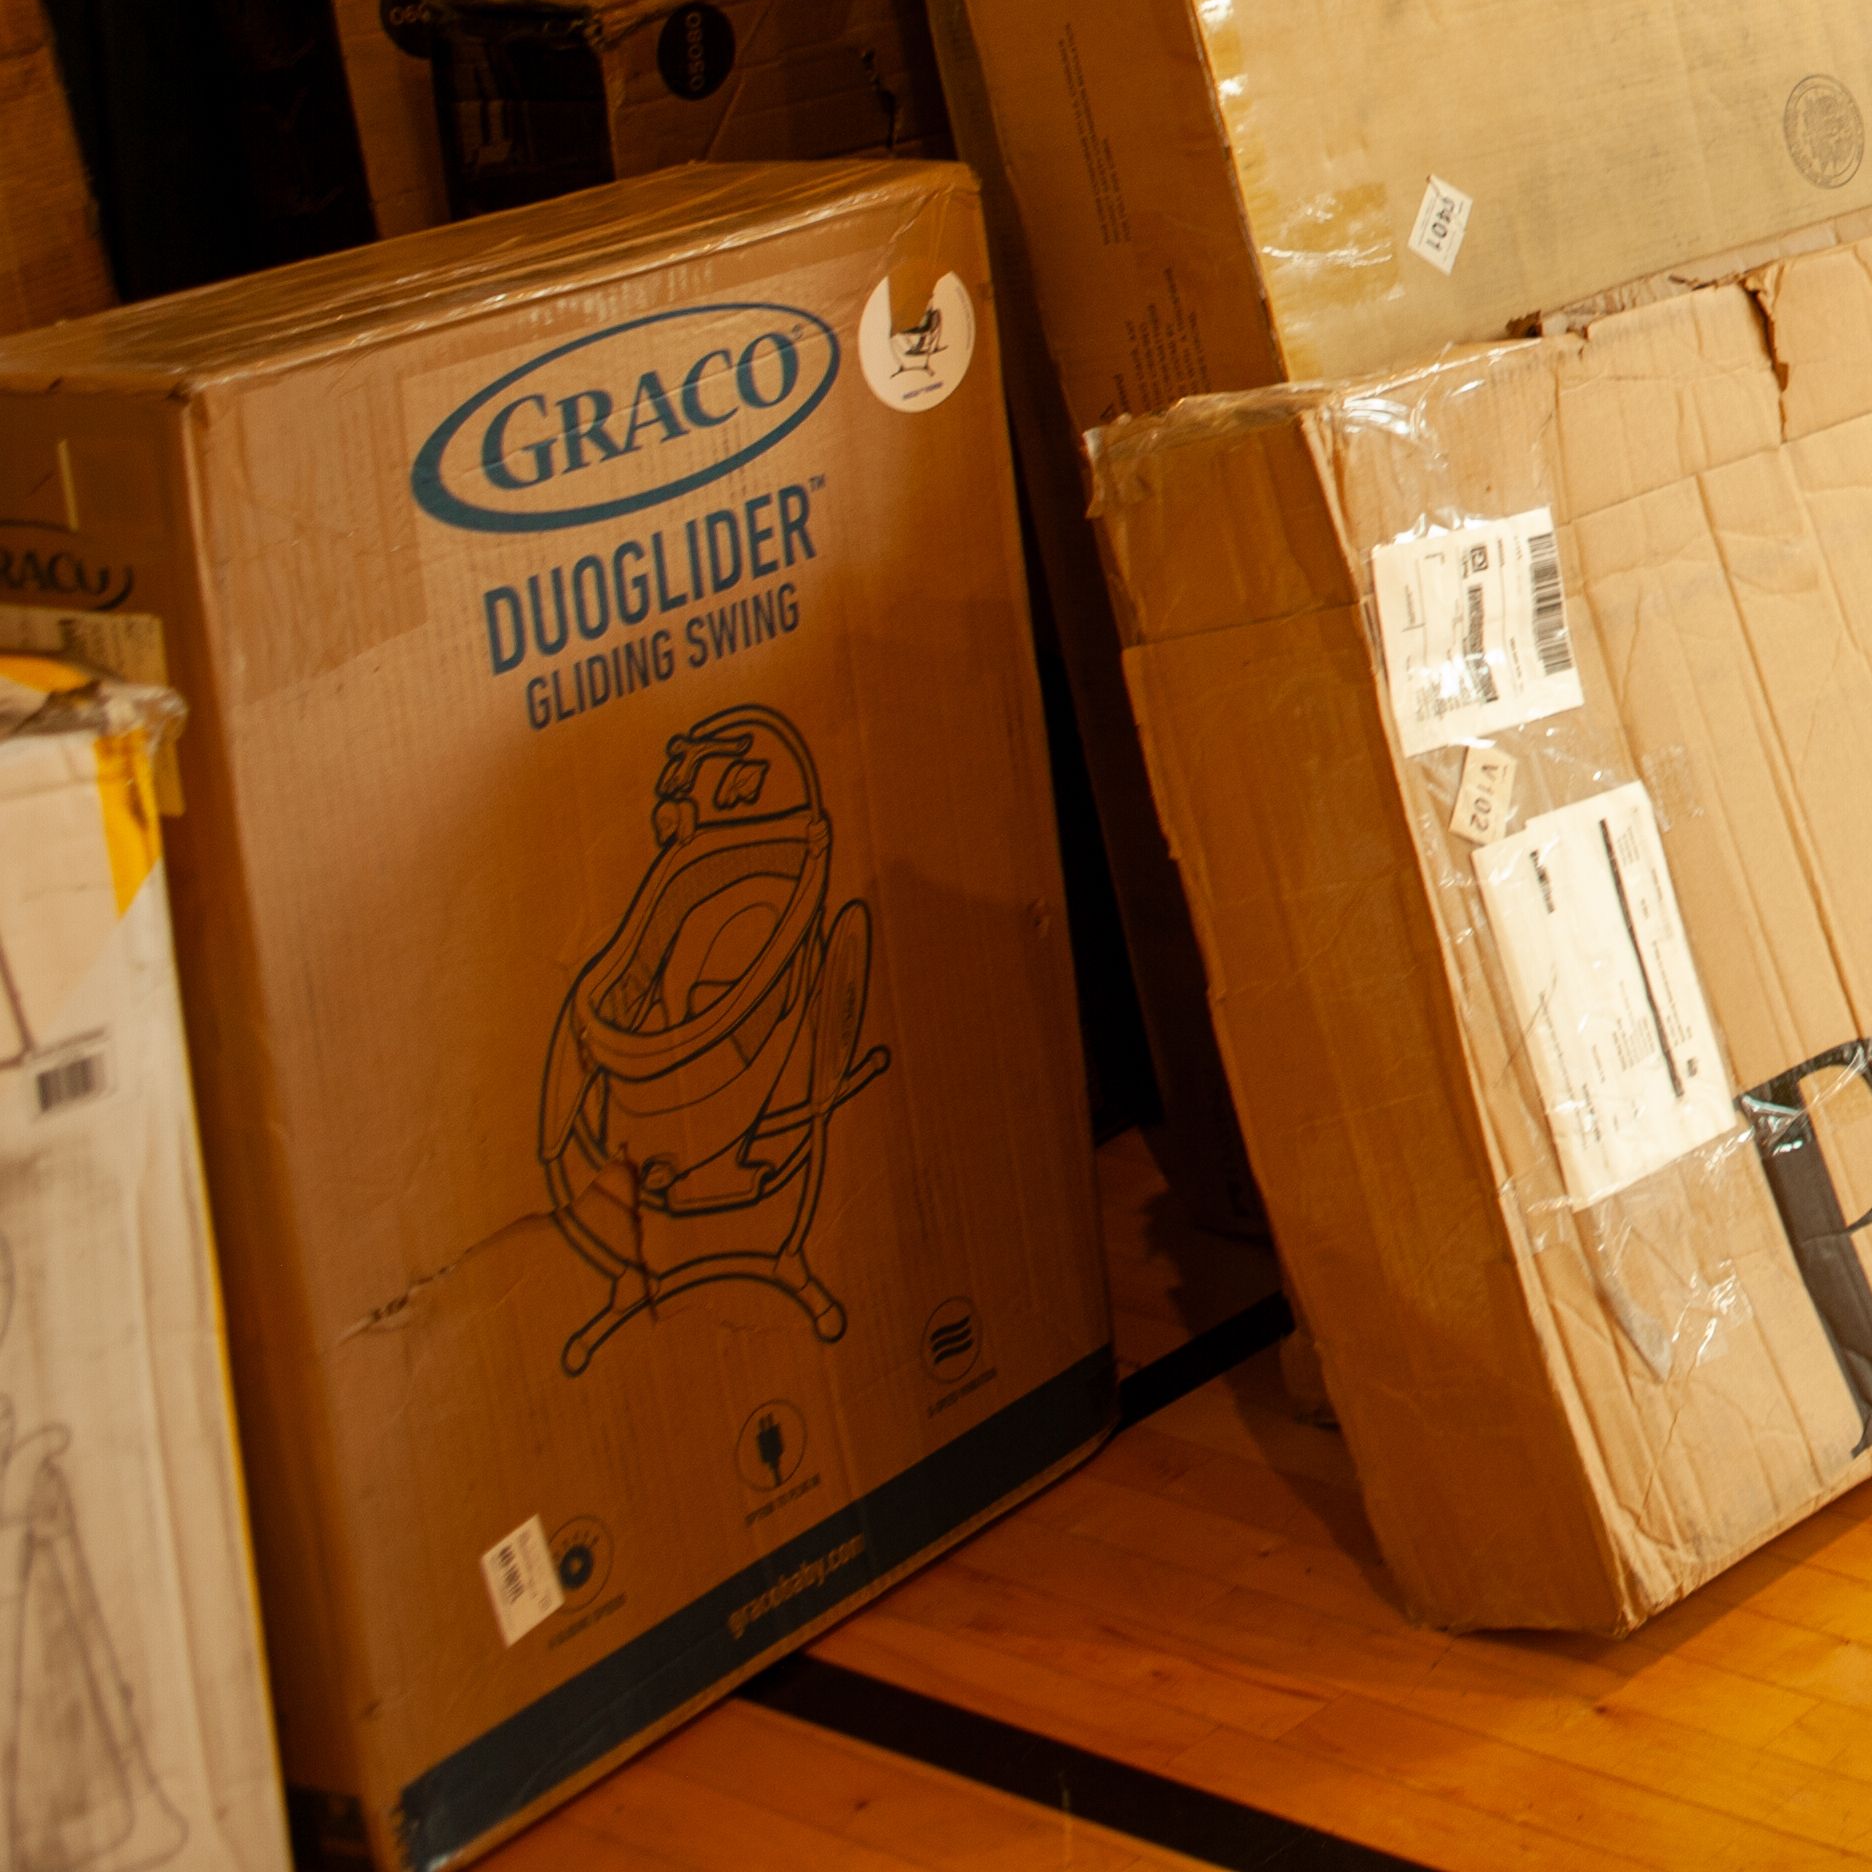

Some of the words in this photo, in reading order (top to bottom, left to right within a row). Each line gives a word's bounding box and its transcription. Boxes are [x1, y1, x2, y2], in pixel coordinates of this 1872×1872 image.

[481, 330, 800, 491] GRACO
[525, 629, 676, 730] GLIDING
[688, 582, 801, 669] SWING
[1464, 761, 1504, 833] V102
[727, 1530, 866, 1640] gracobaby.com
